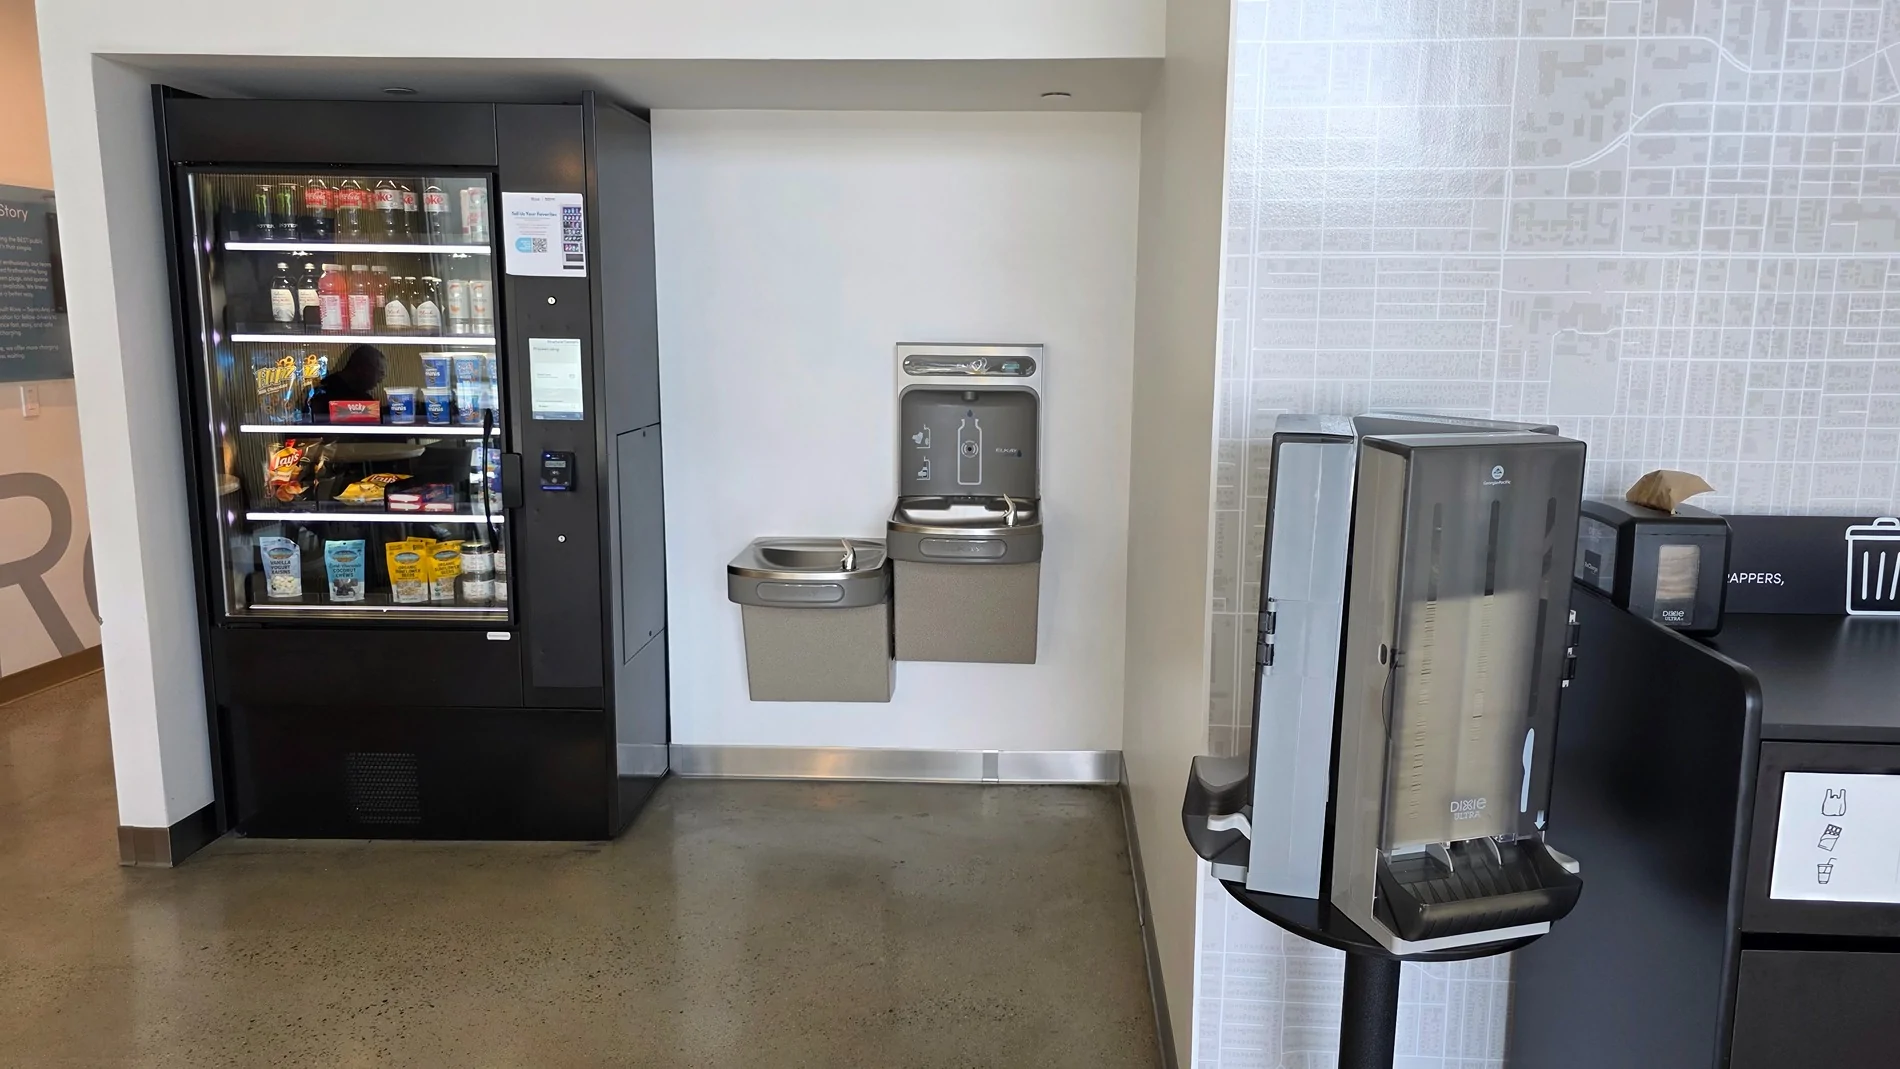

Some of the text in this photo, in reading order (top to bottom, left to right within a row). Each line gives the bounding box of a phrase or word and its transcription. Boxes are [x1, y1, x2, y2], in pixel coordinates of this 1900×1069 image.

[377, 193, 393, 203] oke
[424, 195, 444, 204] oke
[0, 203, 28, 222] Story
[274, 452, 301, 471] Lay's
[1727, 572, 1785, 586] APPERS,
